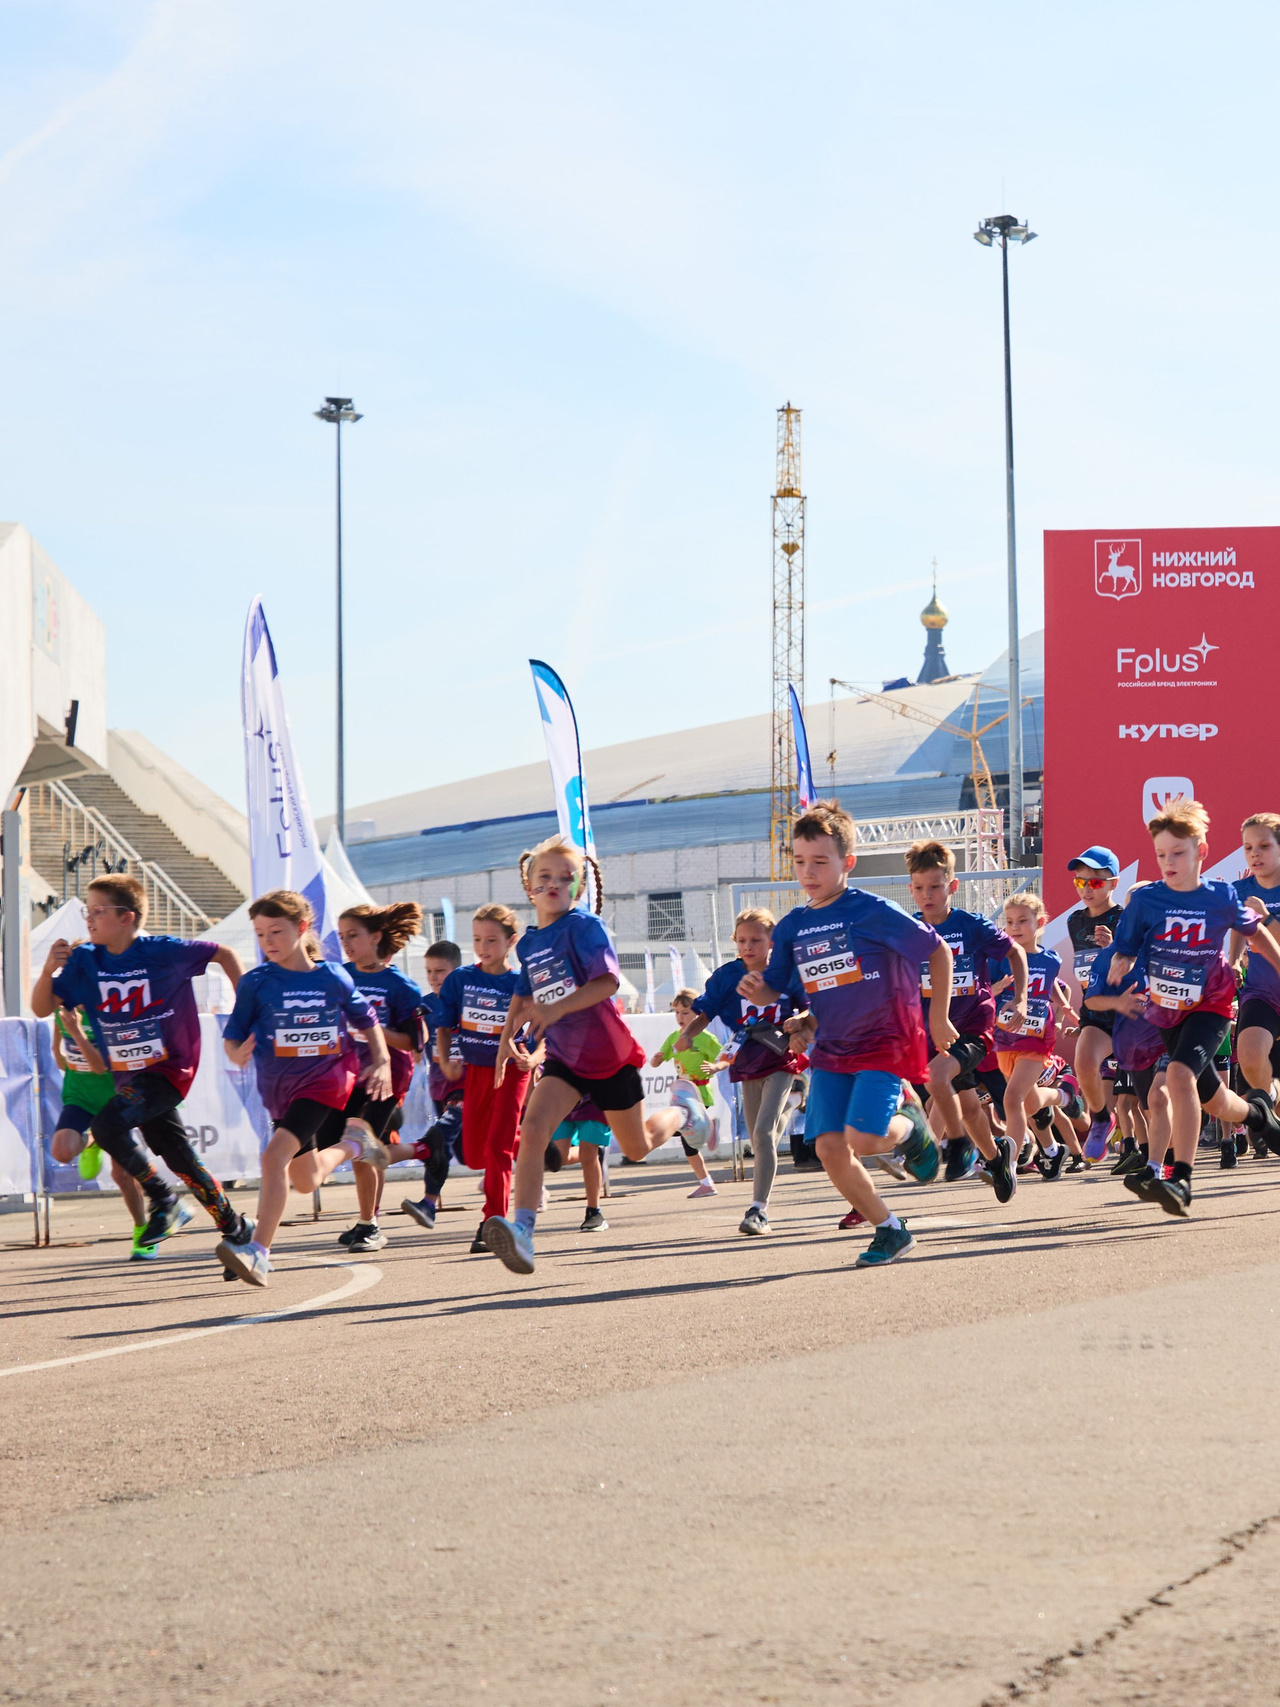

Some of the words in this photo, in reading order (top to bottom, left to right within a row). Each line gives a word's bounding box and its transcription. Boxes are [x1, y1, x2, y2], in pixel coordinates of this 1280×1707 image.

[1152, 547, 1237, 567] НИЖНИЙ
[1152, 571, 1255, 589] НОВГОРОД
[1116, 648, 1199, 679] Fplus
[1118, 723, 1219, 742] купер
[804, 959, 844, 977] 10615
[536, 986, 565, 1004] 0170
[1156, 982, 1190, 997] 10211
[467, 1011, 506, 1023] 10043
[284, 1032, 331, 1043] 10765
[115, 1045, 153, 1059] 10179
